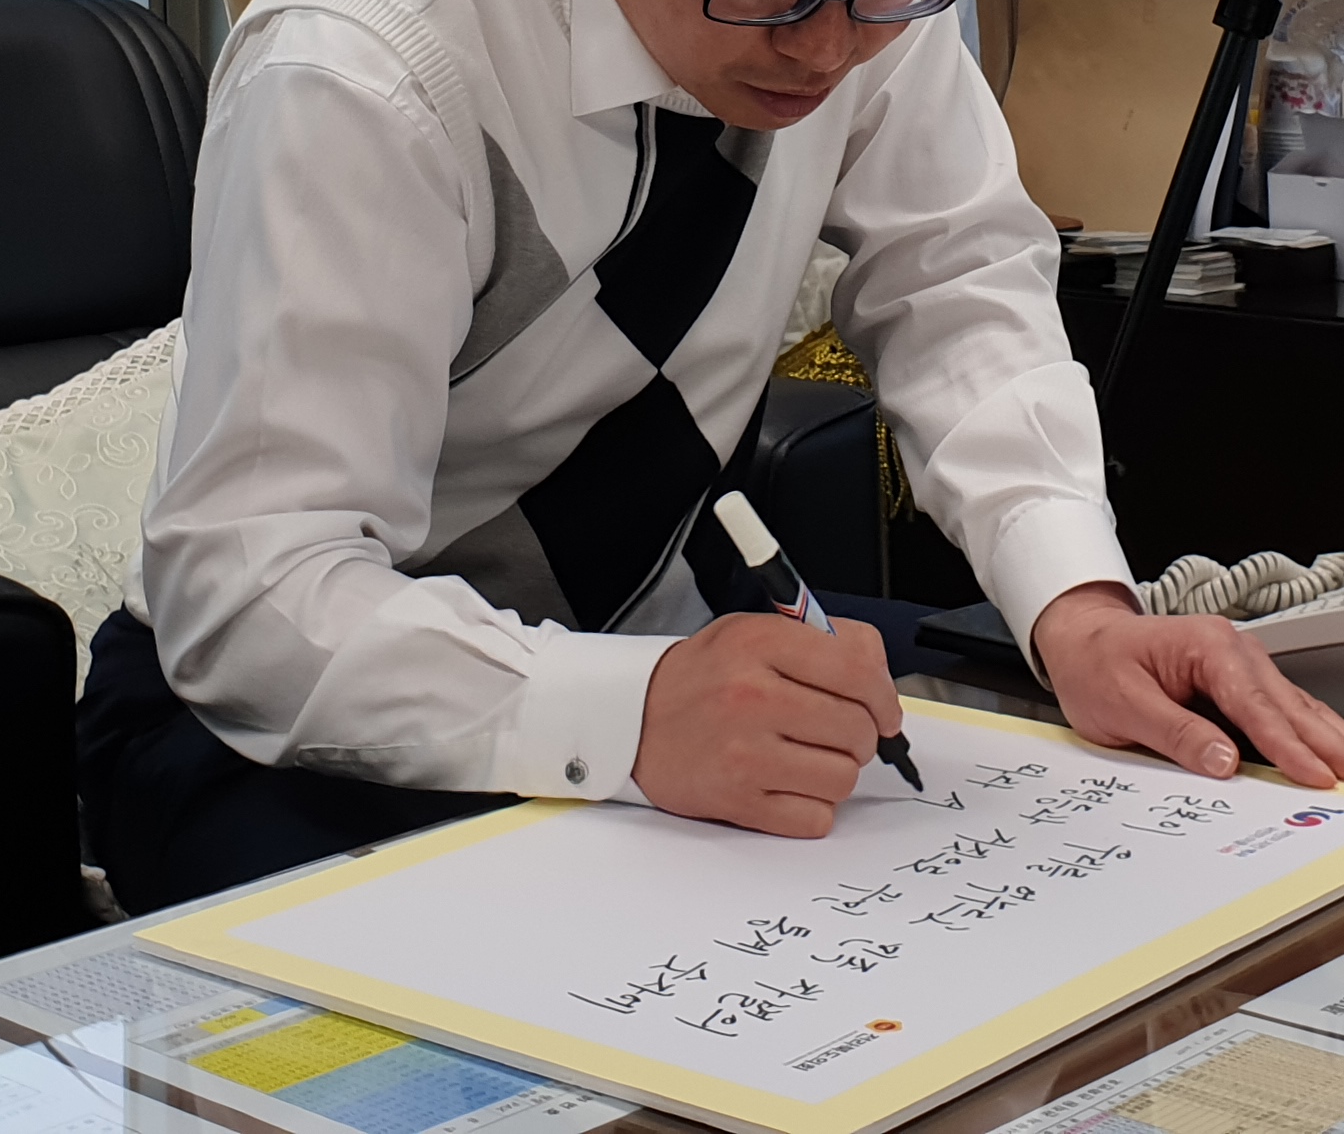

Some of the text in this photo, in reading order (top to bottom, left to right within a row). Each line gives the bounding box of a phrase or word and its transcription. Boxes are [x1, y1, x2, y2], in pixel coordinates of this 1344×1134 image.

[1017, 775, 1140, 825] 불평등과
[673, 794, 1234, 1038] 일본이 우리를 억누르고 민족 차별의
[810, 882, 903, 917] 꾸민
[712, 914, 812, 957] 통계
[566, 953, 708, 1015] 숫자에
